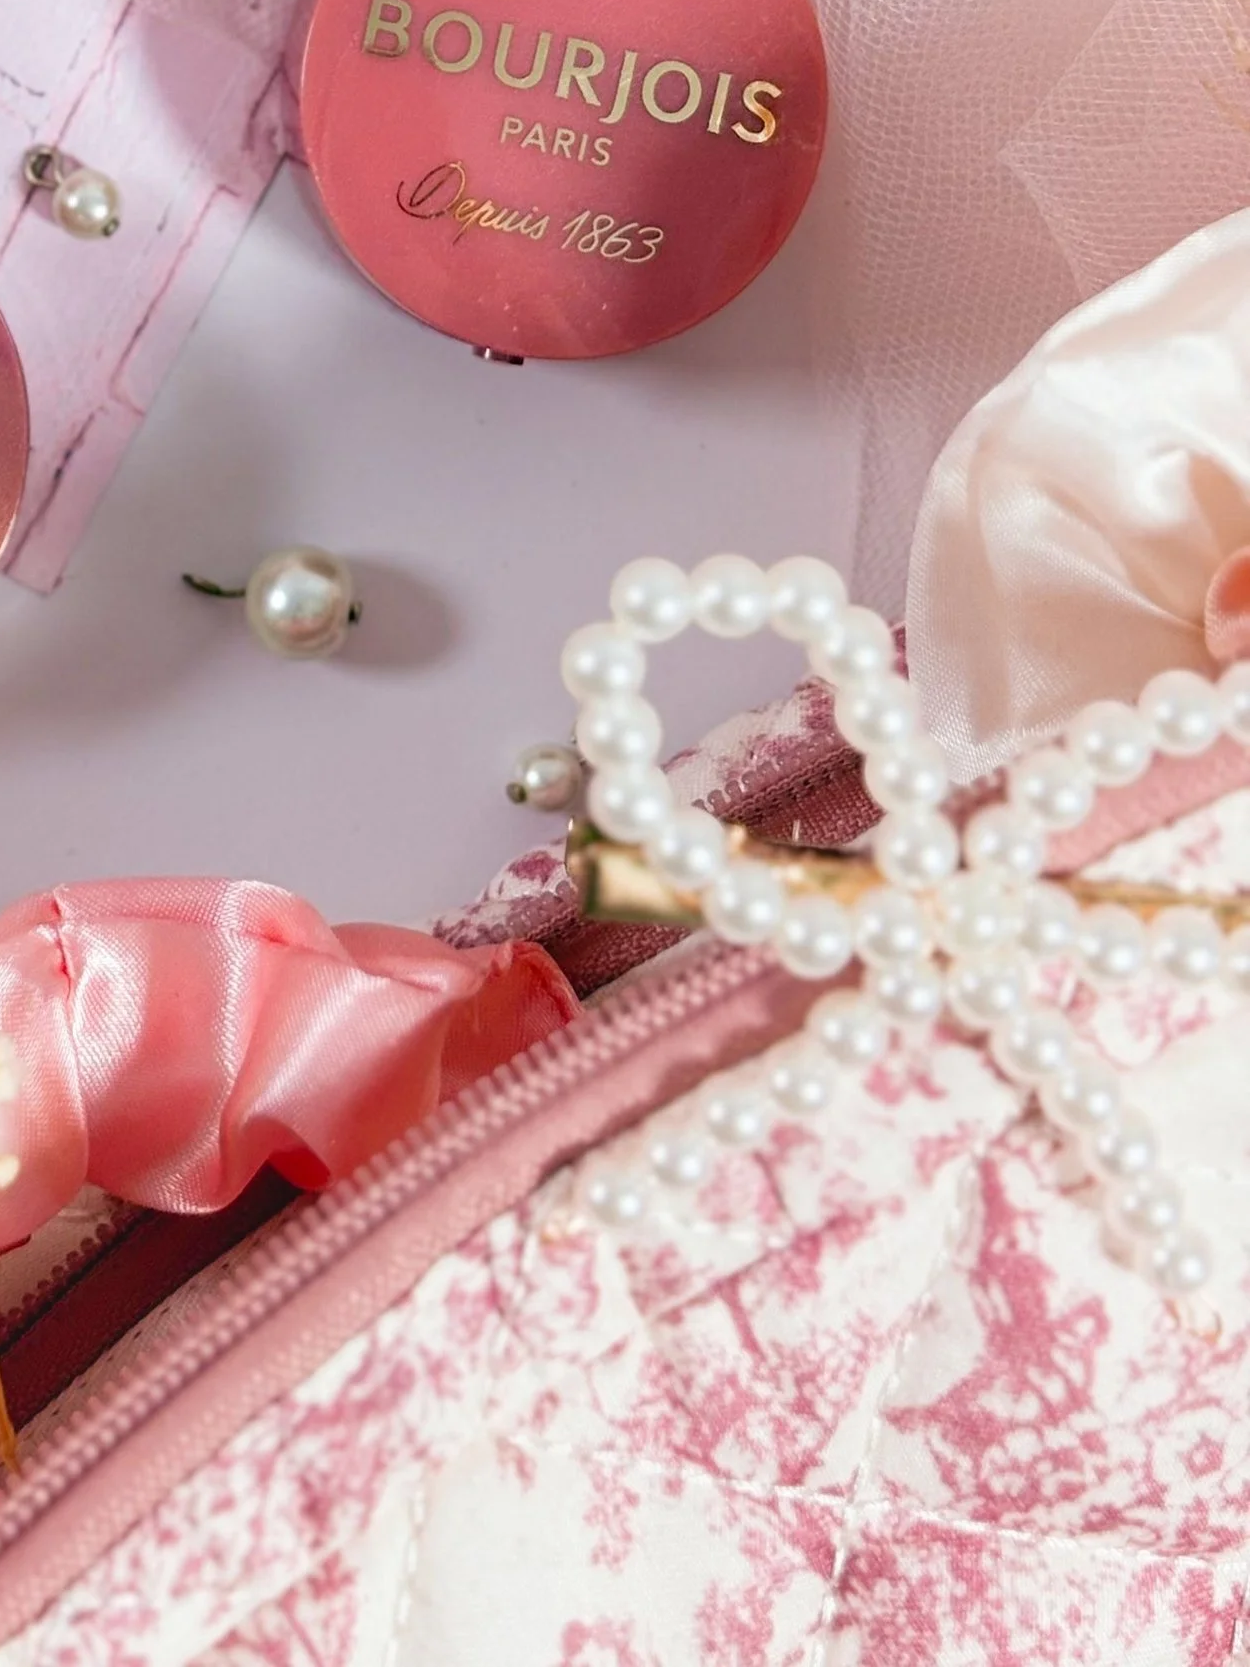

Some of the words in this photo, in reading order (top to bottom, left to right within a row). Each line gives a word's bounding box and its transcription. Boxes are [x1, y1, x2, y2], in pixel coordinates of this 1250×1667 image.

[500, 116, 614, 167] PARIS
[396, 159, 551, 246] Depuis
[560, 209, 664, 263] 1863
